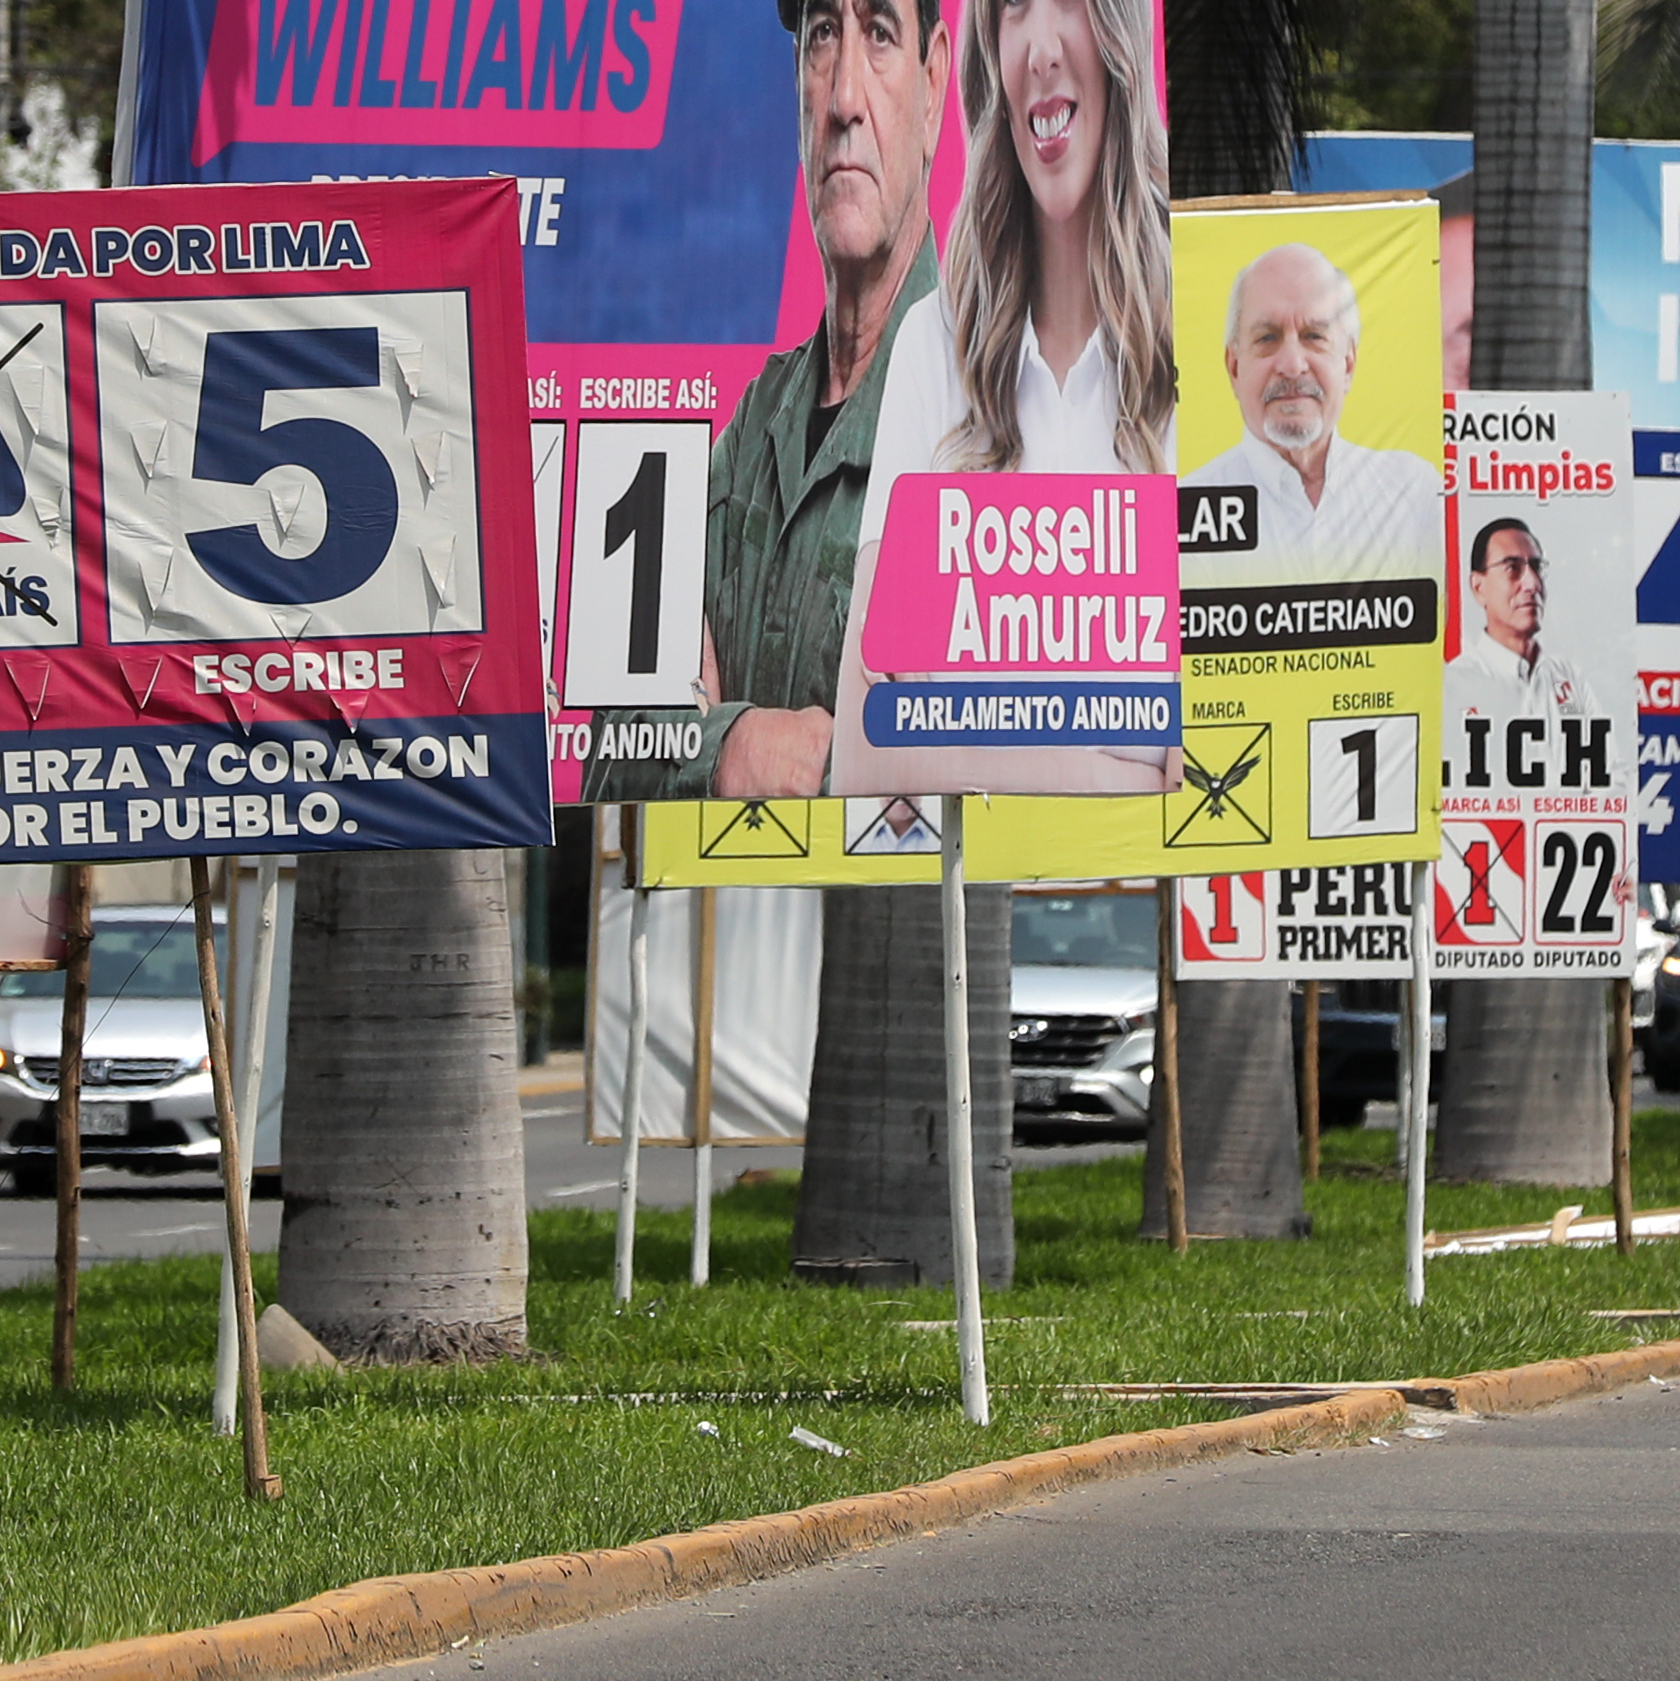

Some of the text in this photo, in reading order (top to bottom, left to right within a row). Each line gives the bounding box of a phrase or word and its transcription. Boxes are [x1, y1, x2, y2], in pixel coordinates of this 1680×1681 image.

[95, 219, 370, 276] POR LIMA
[579, 370, 717, 410] ESCRIBE ASÍ:
[185, 326, 401, 606] 5
[1470, 450, 1614, 500] Limpias
[938, 487, 1137, 575] Rosselli
[603, 451, 668, 675] 1
[946, 576, 1168, 664] Amuruz
[1254, 594, 1414, 633] CATERIANO
[193, 648, 406, 695] ESCRIBE
[1191, 651, 1375, 677] SENADOR NACIONAL
[895, 694, 1170, 732] PARLAMENTO ANDINO
[1192, 701, 1247, 720] MARCA
[1332, 691, 1395, 712] ESCRIBE
[147, 740, 191, 787] Y
[197, 733, 490, 787] CORAZON
[598, 722, 702, 761] ANDINO
[1442, 718, 1612, 789] ICH
[1340, 728, 1377, 822] 1
[60, 803, 118, 845] EL
[128, 792, 359, 844] PUEBLO.
[1440, 794, 1522, 813] MARCA ASÍ
[1534, 794, 1629, 813] ESCRIBE ASÍ
[1464, 841, 1497, 925] 1
[1542, 831, 1617, 934] 22
[1277, 925, 1409, 961] PRIMER
[1435, 950, 1622, 969] DIPUTADO DIPUTADO
